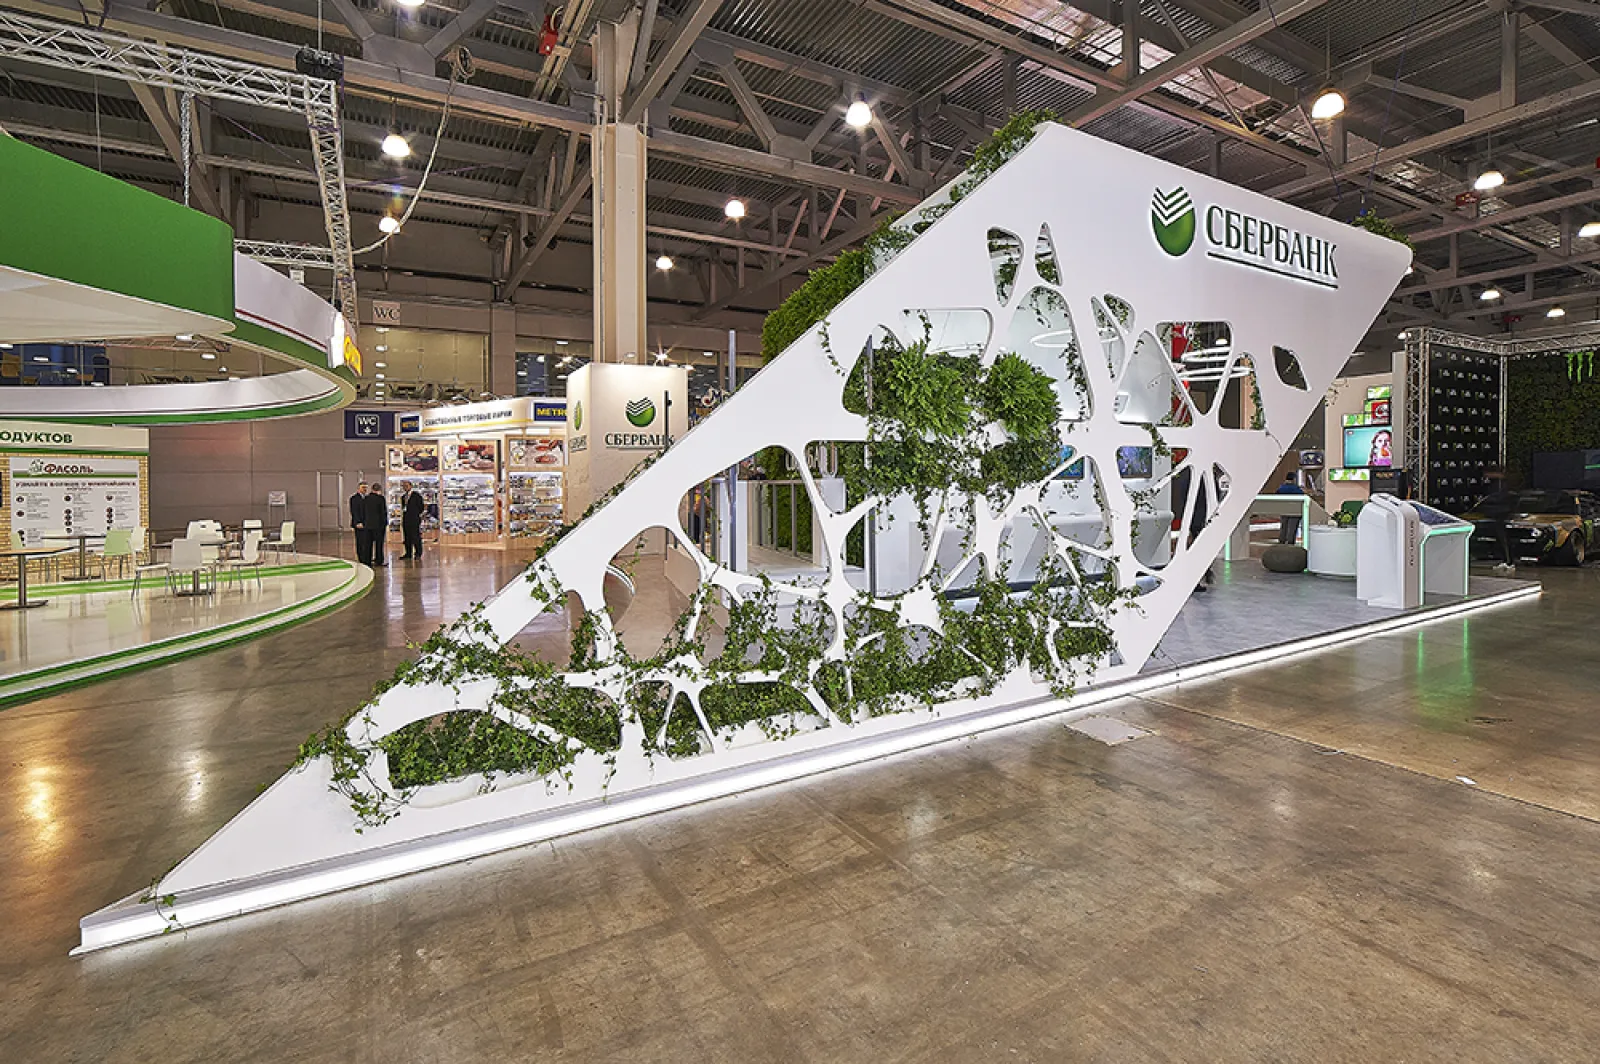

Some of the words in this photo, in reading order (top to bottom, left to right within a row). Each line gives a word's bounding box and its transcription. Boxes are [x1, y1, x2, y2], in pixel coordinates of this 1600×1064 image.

[1206, 205, 1338, 279] СБЕРБАНК
[374, 306, 400, 320] WC
[358, 416, 377, 425] WC
